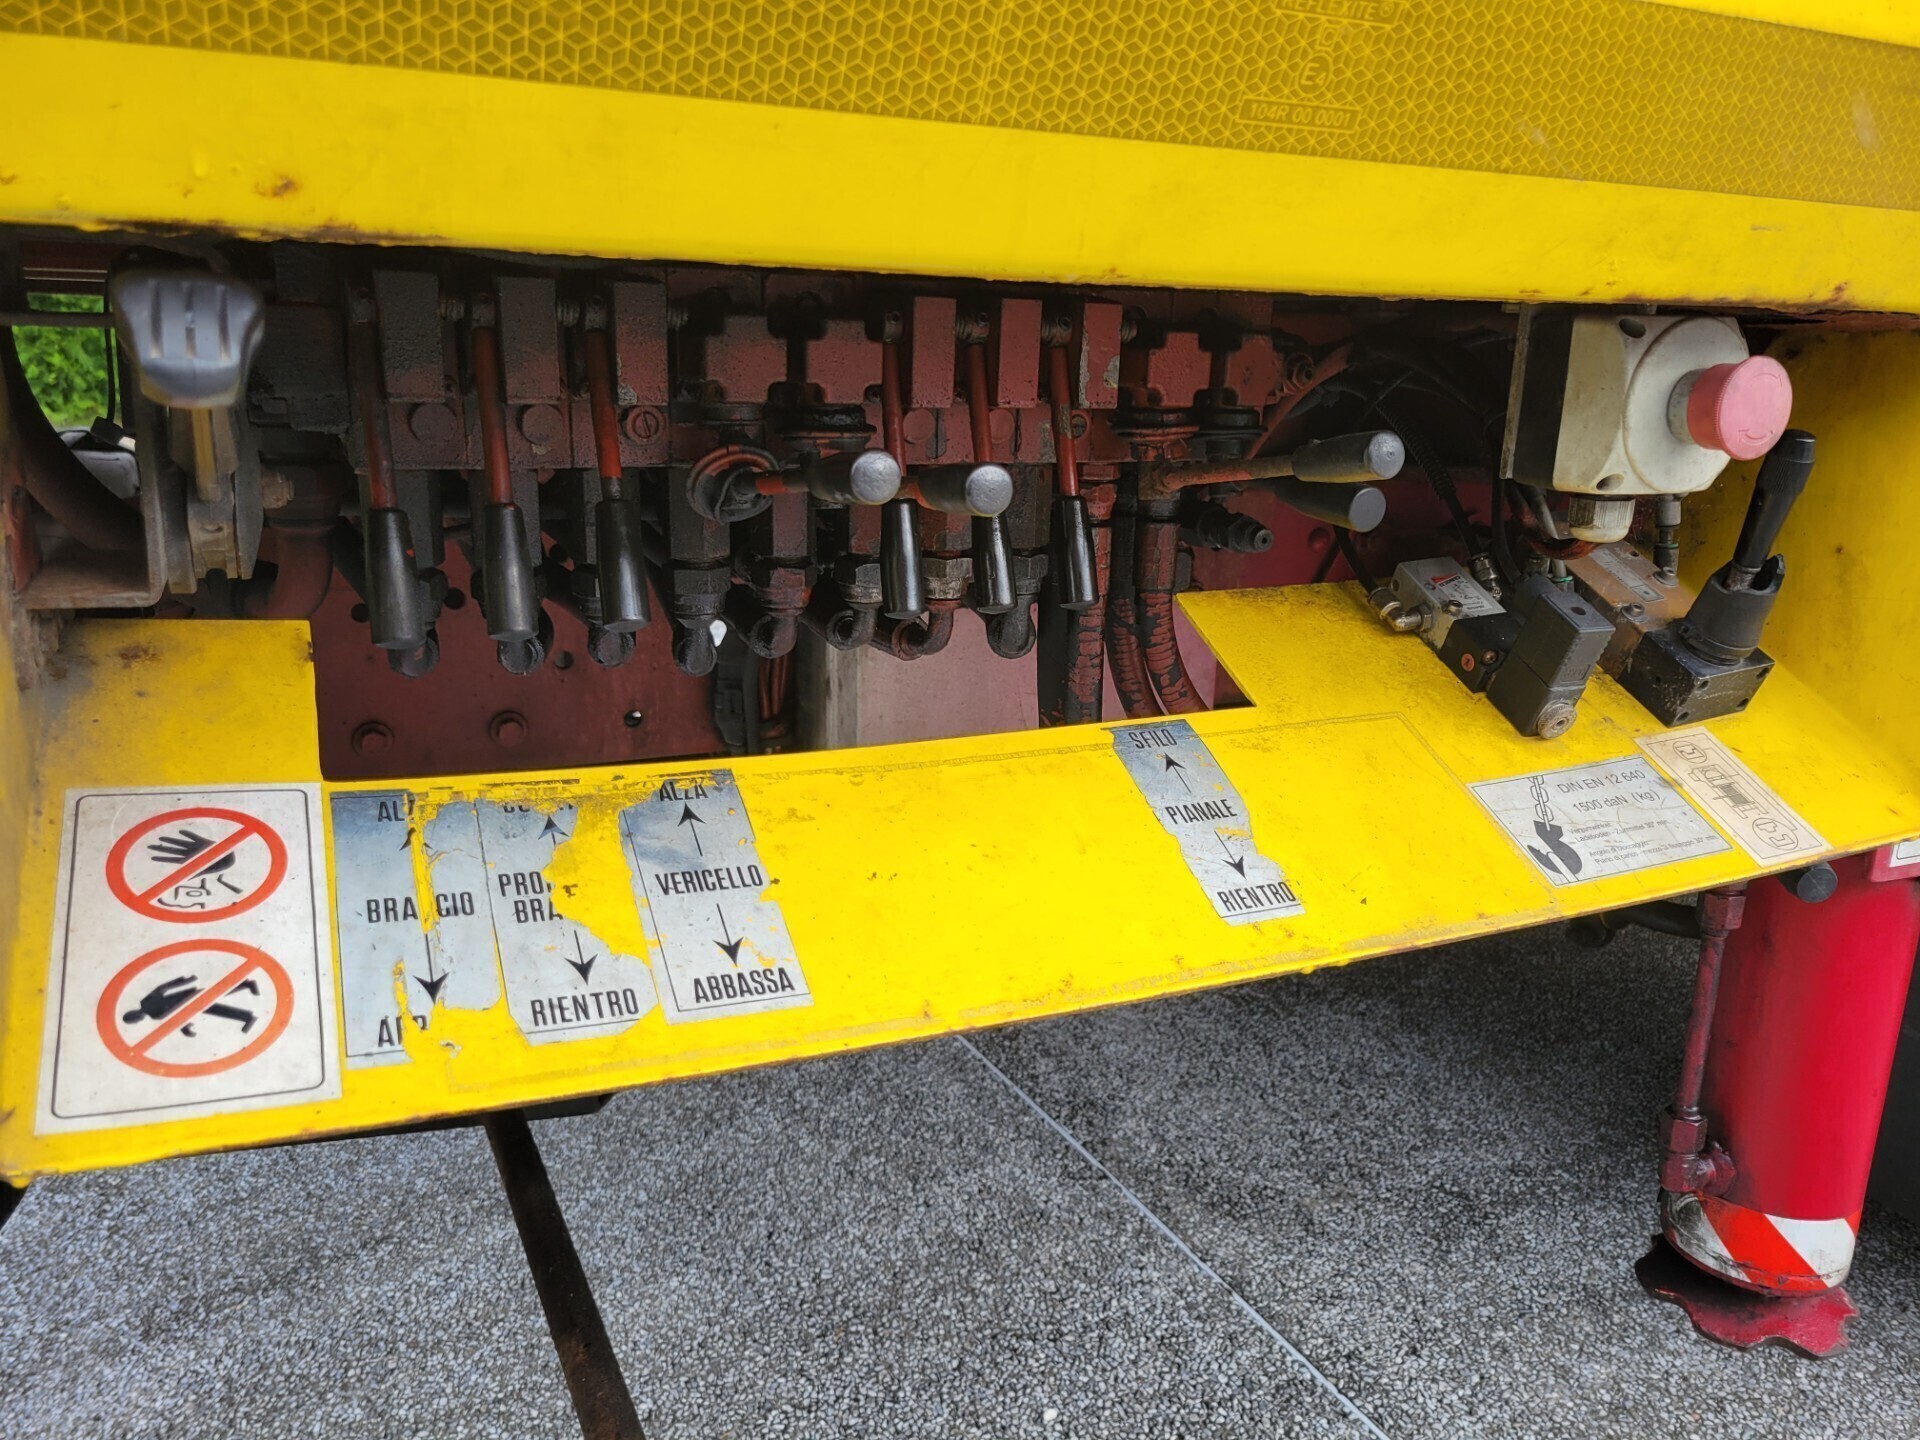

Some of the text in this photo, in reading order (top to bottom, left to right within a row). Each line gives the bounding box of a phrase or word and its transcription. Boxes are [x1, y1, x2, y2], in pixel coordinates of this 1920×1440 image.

[1251, 103, 1289, 121] 104R
[1292, 108, 1312, 124] 00
[1128, 729, 1177, 749] SFILO
[1557, 769, 1646, 793] DIN EN 12 640
[1165, 799, 1237, 825] PIANALE
[1573, 799, 1603, 812] 1500
[1604, 795, 1629, 808] daN
[655, 864, 763, 895] VERICELLO
[366, 891, 475, 923] BRACIO
[1217, 881, 1296, 912] RIENTRO
[693, 967, 795, 1004] ABBASSA
[530, 988, 640, 1027] RIENTRO
